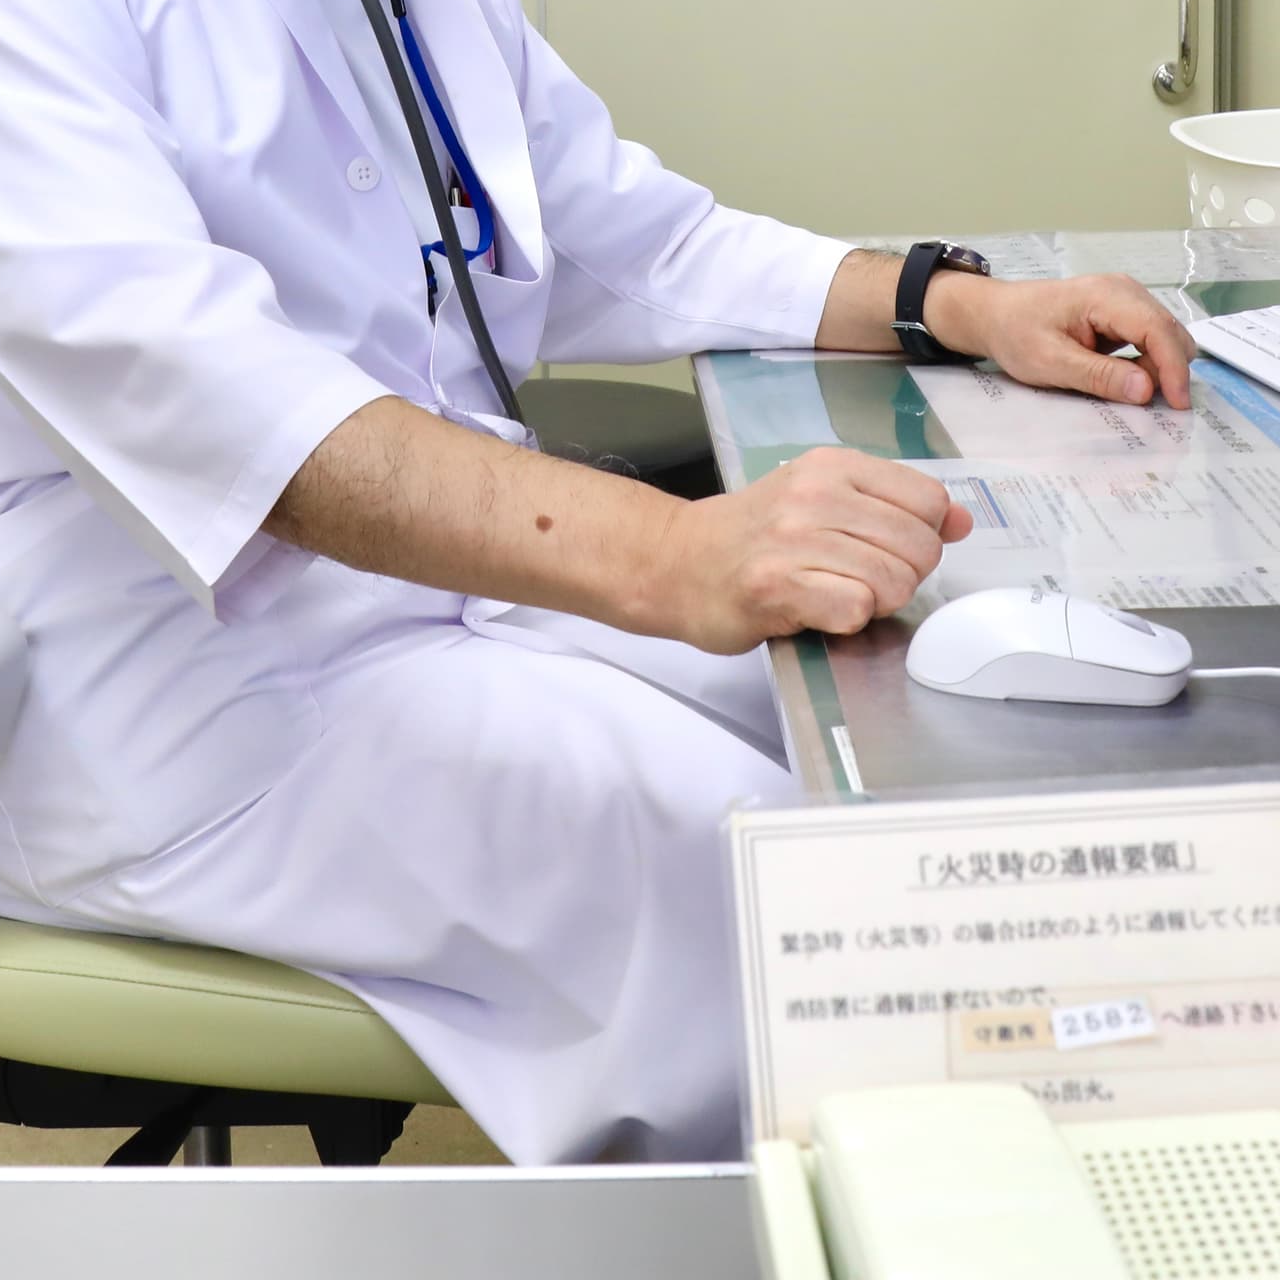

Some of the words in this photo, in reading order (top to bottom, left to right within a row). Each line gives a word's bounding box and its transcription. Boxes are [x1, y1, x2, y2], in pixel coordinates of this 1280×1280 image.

[917, 840, 1197, 886] 「火災時の通報要領」
